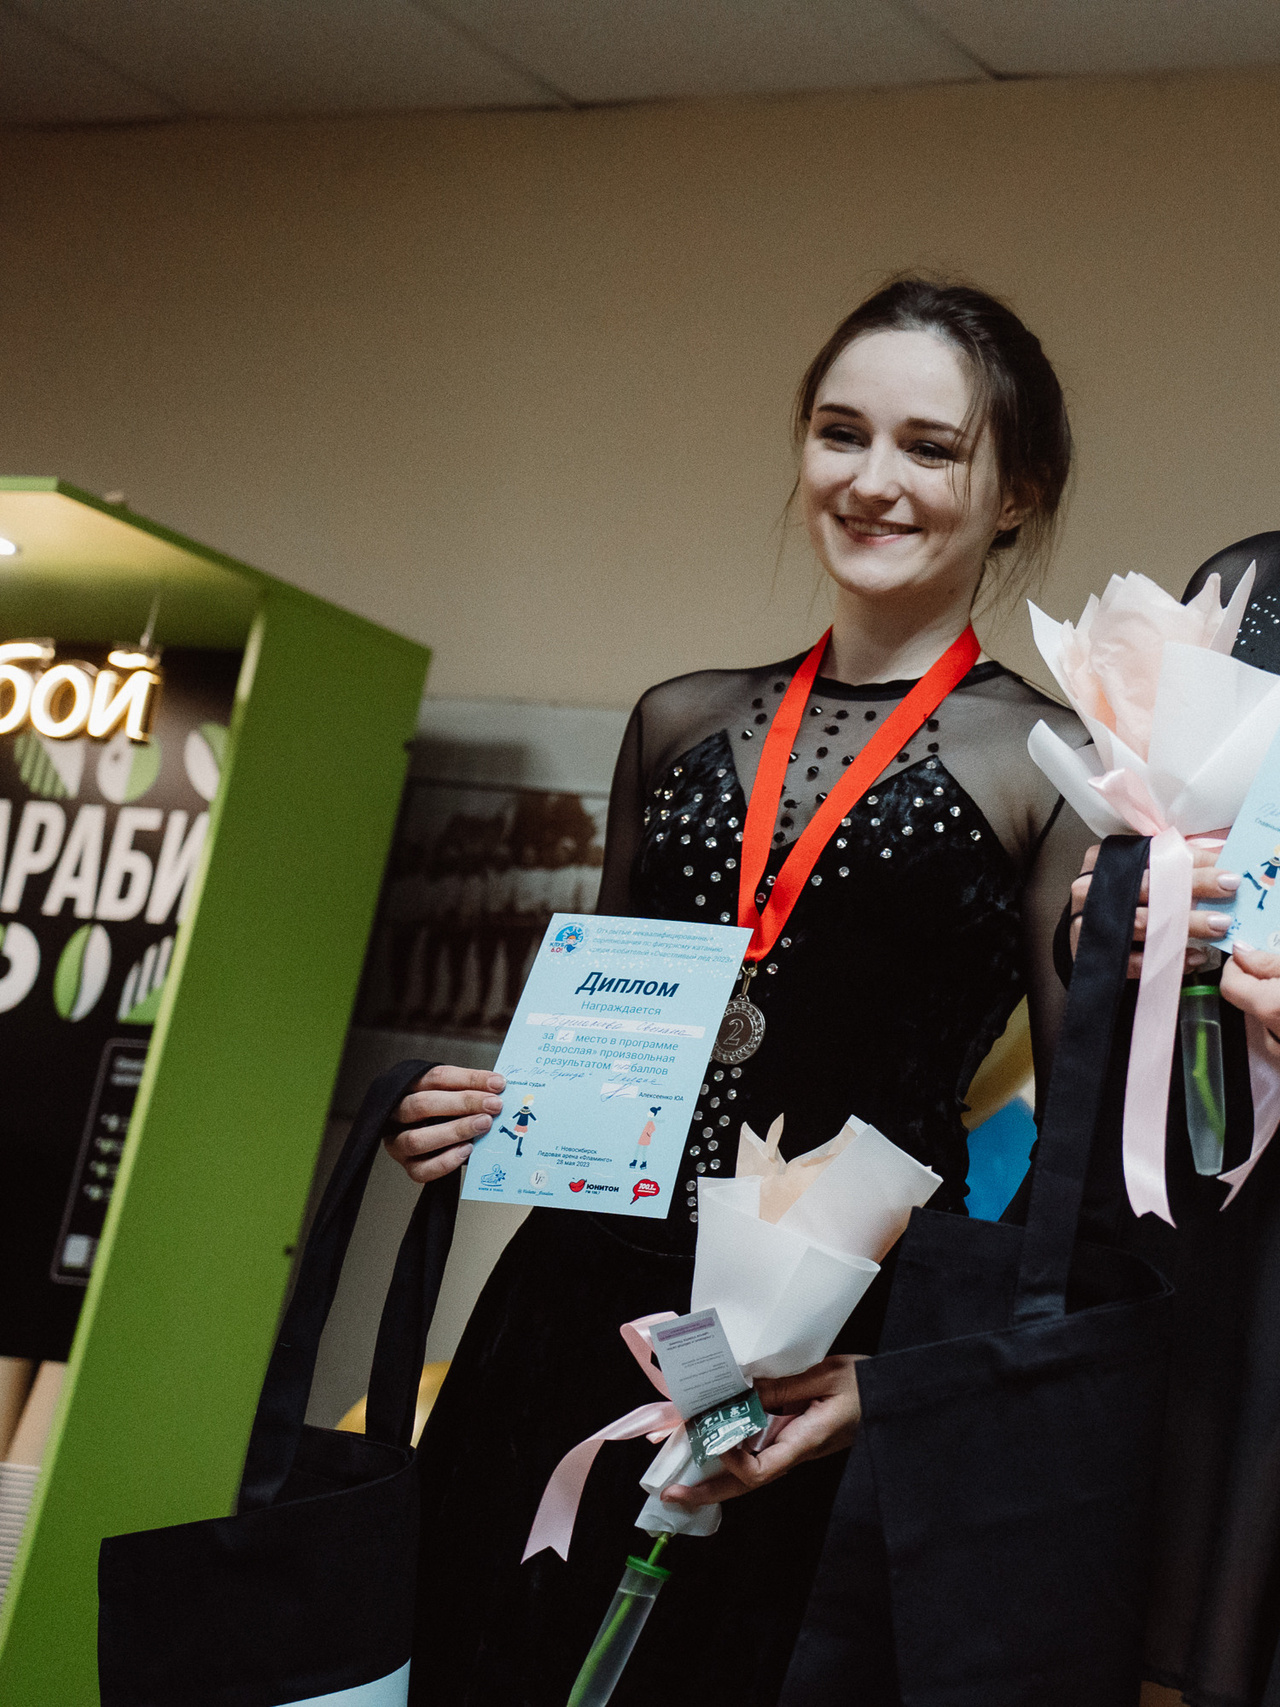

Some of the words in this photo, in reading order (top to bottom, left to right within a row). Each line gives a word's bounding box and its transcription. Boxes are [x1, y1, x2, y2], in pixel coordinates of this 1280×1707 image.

[0, 798, 210, 925] РАБИ
[574, 971, 680, 998] Диплом
[581, 1001, 662, 1016] Награждается
[542, 1032, 555, 1041] за
[575, 1034, 608, 1046] место
[610, 1037, 617, 1046] в
[619, 1038, 679, 1051] программе
[723, 1018, 744, 1046] 2
[537, 1043, 598, 1056] «Взрослая»
[599, 1049, 676, 1064] произвольная
[535, 1056, 543, 1064] с
[543, 1056, 611, 1070] результатом
[630, 1062, 669, 1076] баллов
[586, 1183, 619, 1193] ЮНИТОН
